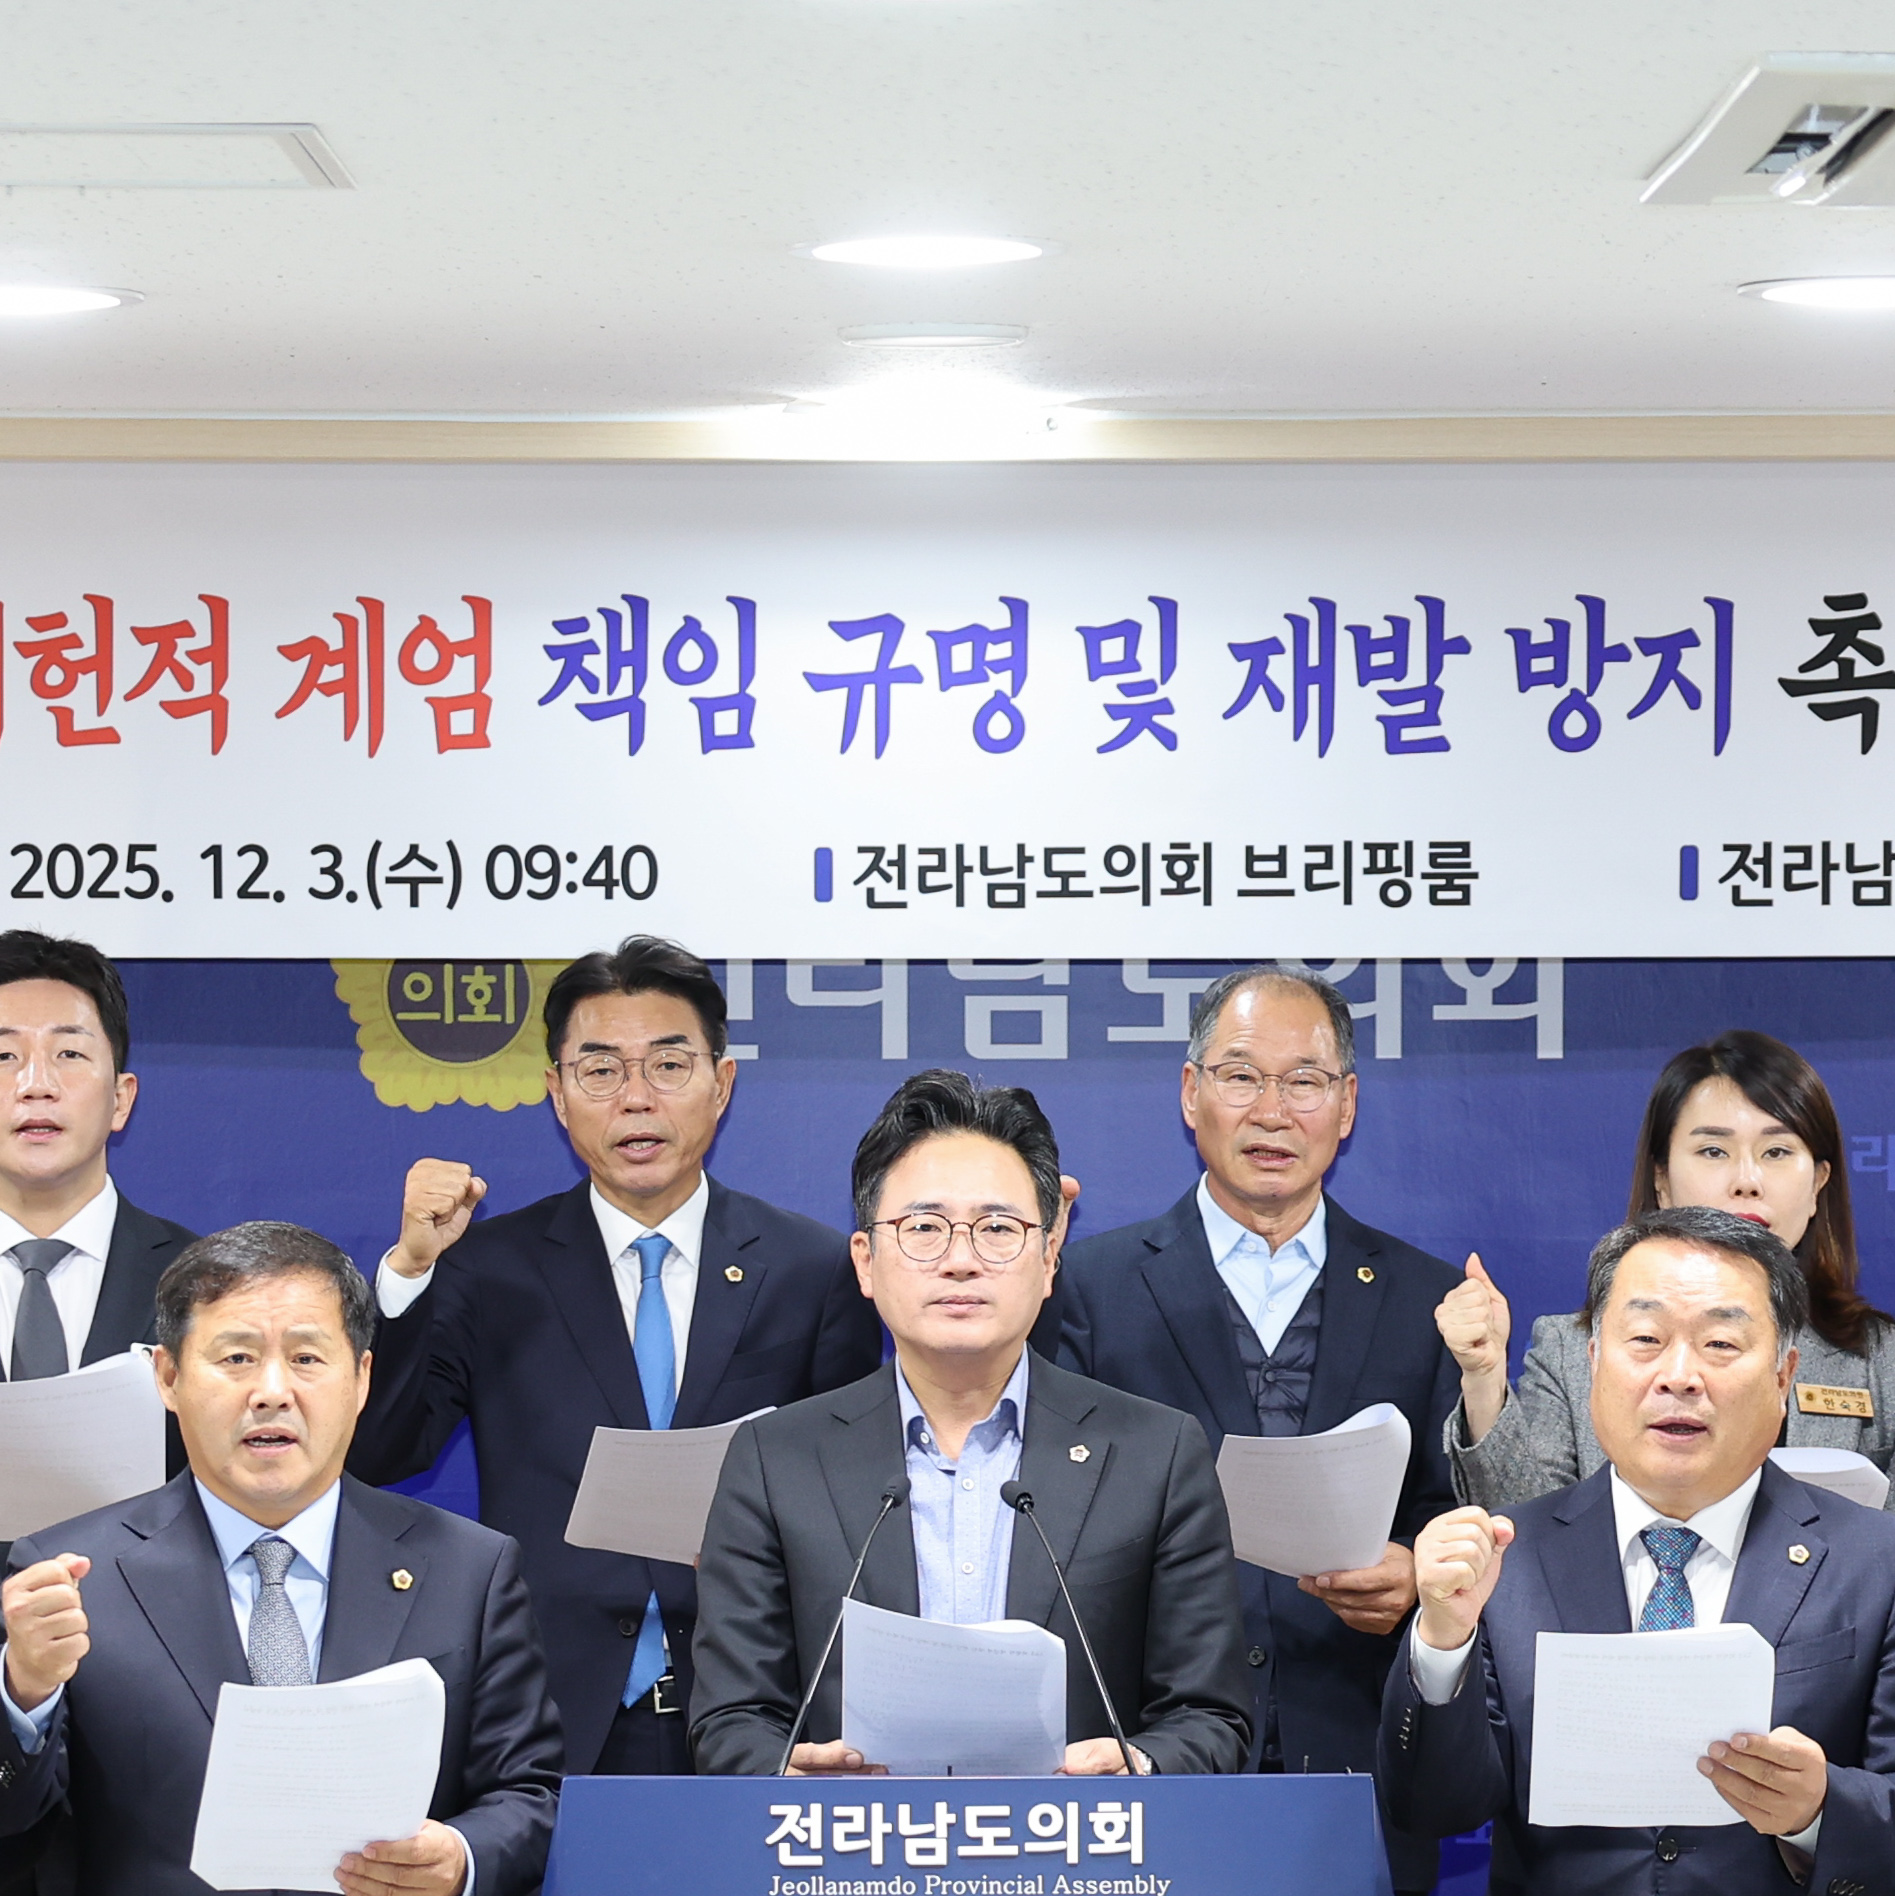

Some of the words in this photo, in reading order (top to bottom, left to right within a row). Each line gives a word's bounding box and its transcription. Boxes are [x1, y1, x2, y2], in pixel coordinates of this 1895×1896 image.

[275, 596, 494, 760] 계엄
[538, 594, 759, 758] 책임
[802, 597, 1031, 760] 규명
[1075, 595, 1180, 756] 및
[1222, 595, 1474, 760] 재발
[1504, 594, 1736, 758] 방지
[10, 844, 176, 905] 2025.
[200, 844, 287, 905] 12.
[308, 839, 464, 912] 3.(수)
[485, 844, 660, 903] 09:40
[853, 842, 1214, 911] 전라남도의회
[1237, 840, 1481, 910] 브리핑룸
[395, 962, 516, 1025] 의회
[764, 1800, 1145, 1868] 전라남도의회
[768, 1874, 917, 1896] Jeollanamdo
[923, 1874, 1045, 1896] Provincial
